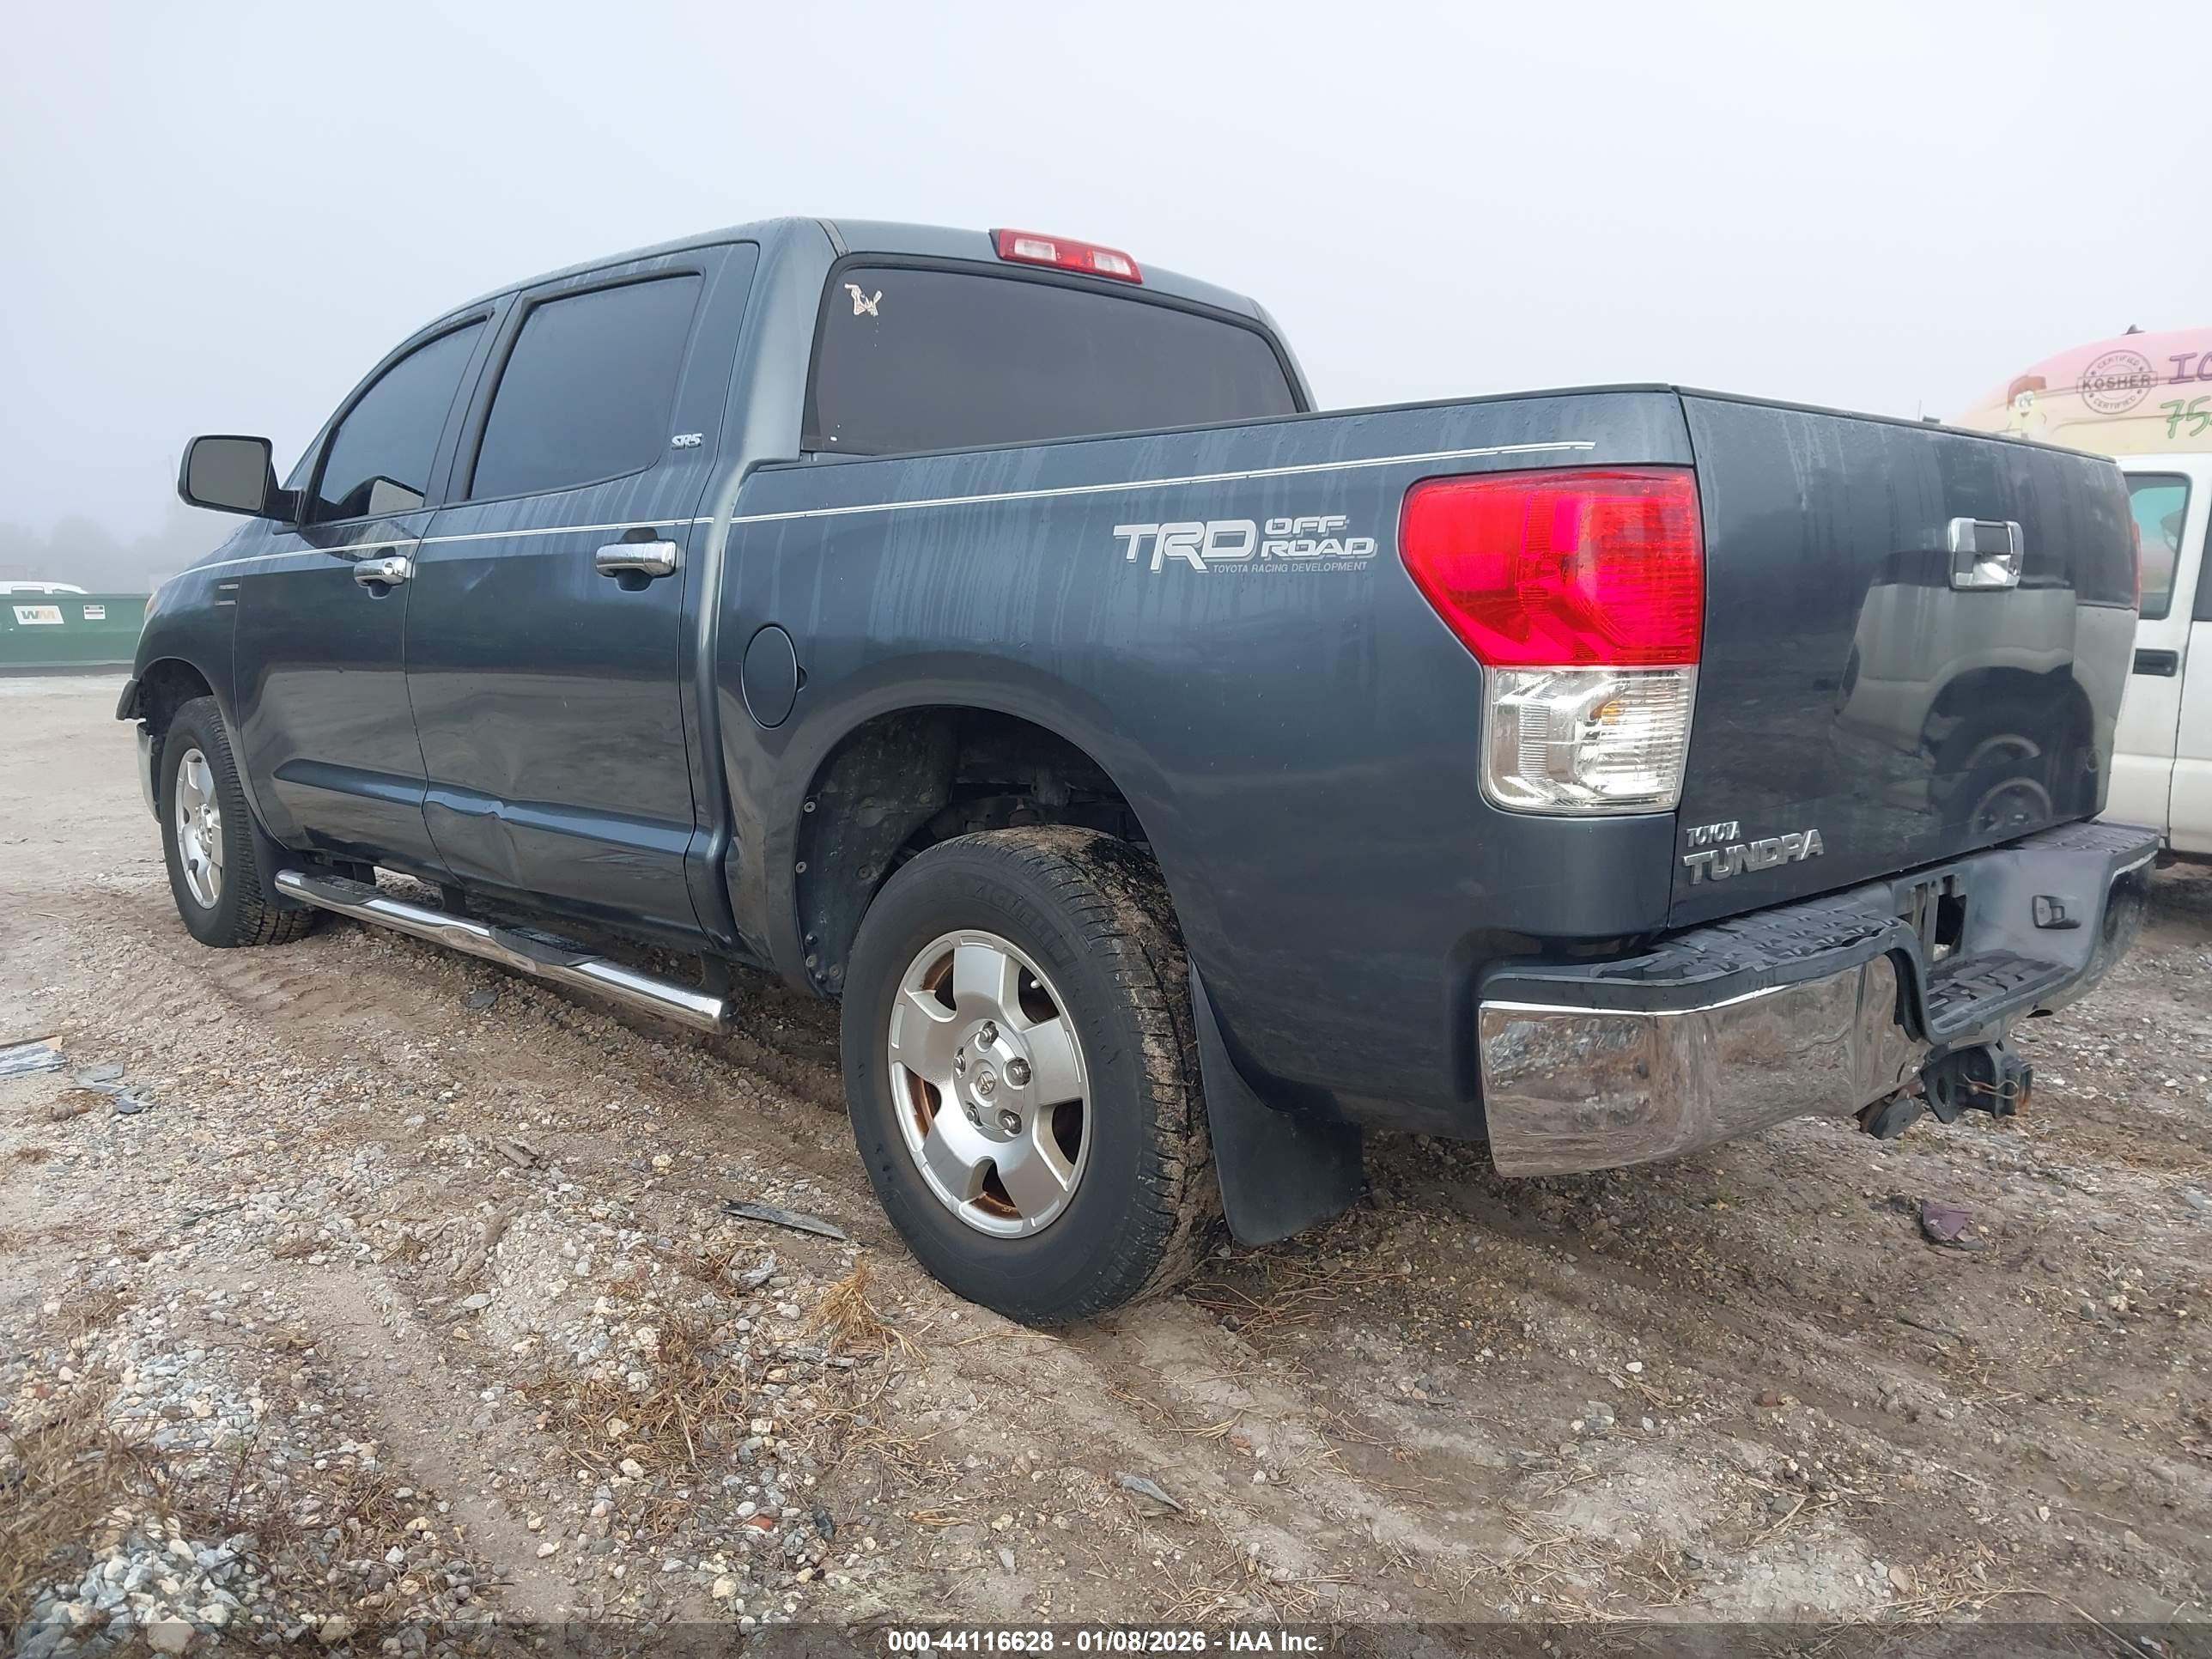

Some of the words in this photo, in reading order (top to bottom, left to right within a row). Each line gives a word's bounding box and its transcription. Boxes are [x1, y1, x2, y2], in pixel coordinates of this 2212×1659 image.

[2097, 355, 2140, 369] CERTIFIED
[2082, 374, 2151, 390] KOSHER
[2093, 395, 2137, 410] CERTIFIED
[2160, 395, 2212, 439] 75
[1264, 515, 1349, 536] OFF
[1113, 520, 1257, 573] TRD
[1261, 538, 1377, 559] ROAD
[1213, 564, 1249, 573] TOYOTA
[1251, 563, 1288, 573] RACING
[1291, 562, 1367, 573] DEVELOPMENT
[21, 611, 56, 619] WM
[1686, 821, 1741, 847] TOYOTA
[1682, 829, 1824, 885] TUNDRA
